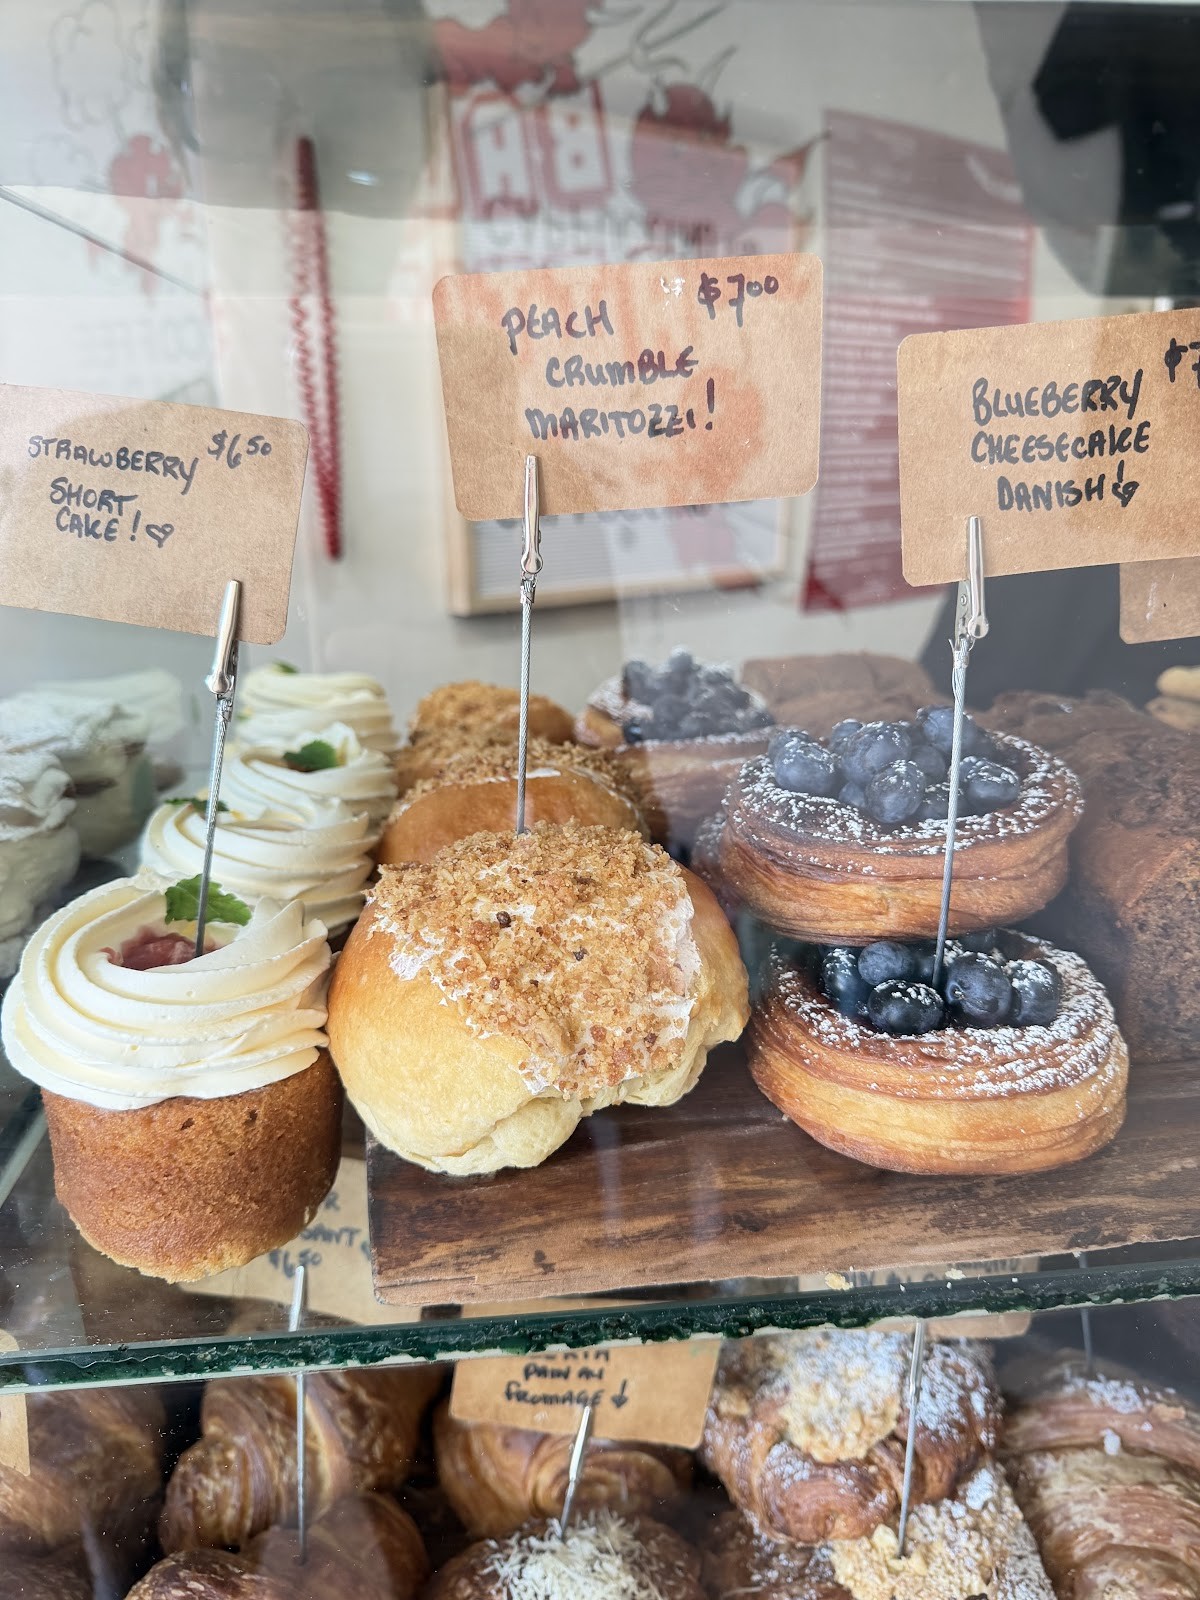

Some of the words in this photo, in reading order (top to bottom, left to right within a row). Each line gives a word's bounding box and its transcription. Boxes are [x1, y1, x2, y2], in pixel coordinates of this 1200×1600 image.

[501, 300, 614, 355] PEACH
[546, 346, 699, 387] CRUMBLE
[972, 369, 1144, 426] BLUEBERRY
[27, 435, 199, 495] STRAWBERRY
[970, 421, 1151, 464] CHEESECAKE
[50, 476, 139, 516] SHORT
